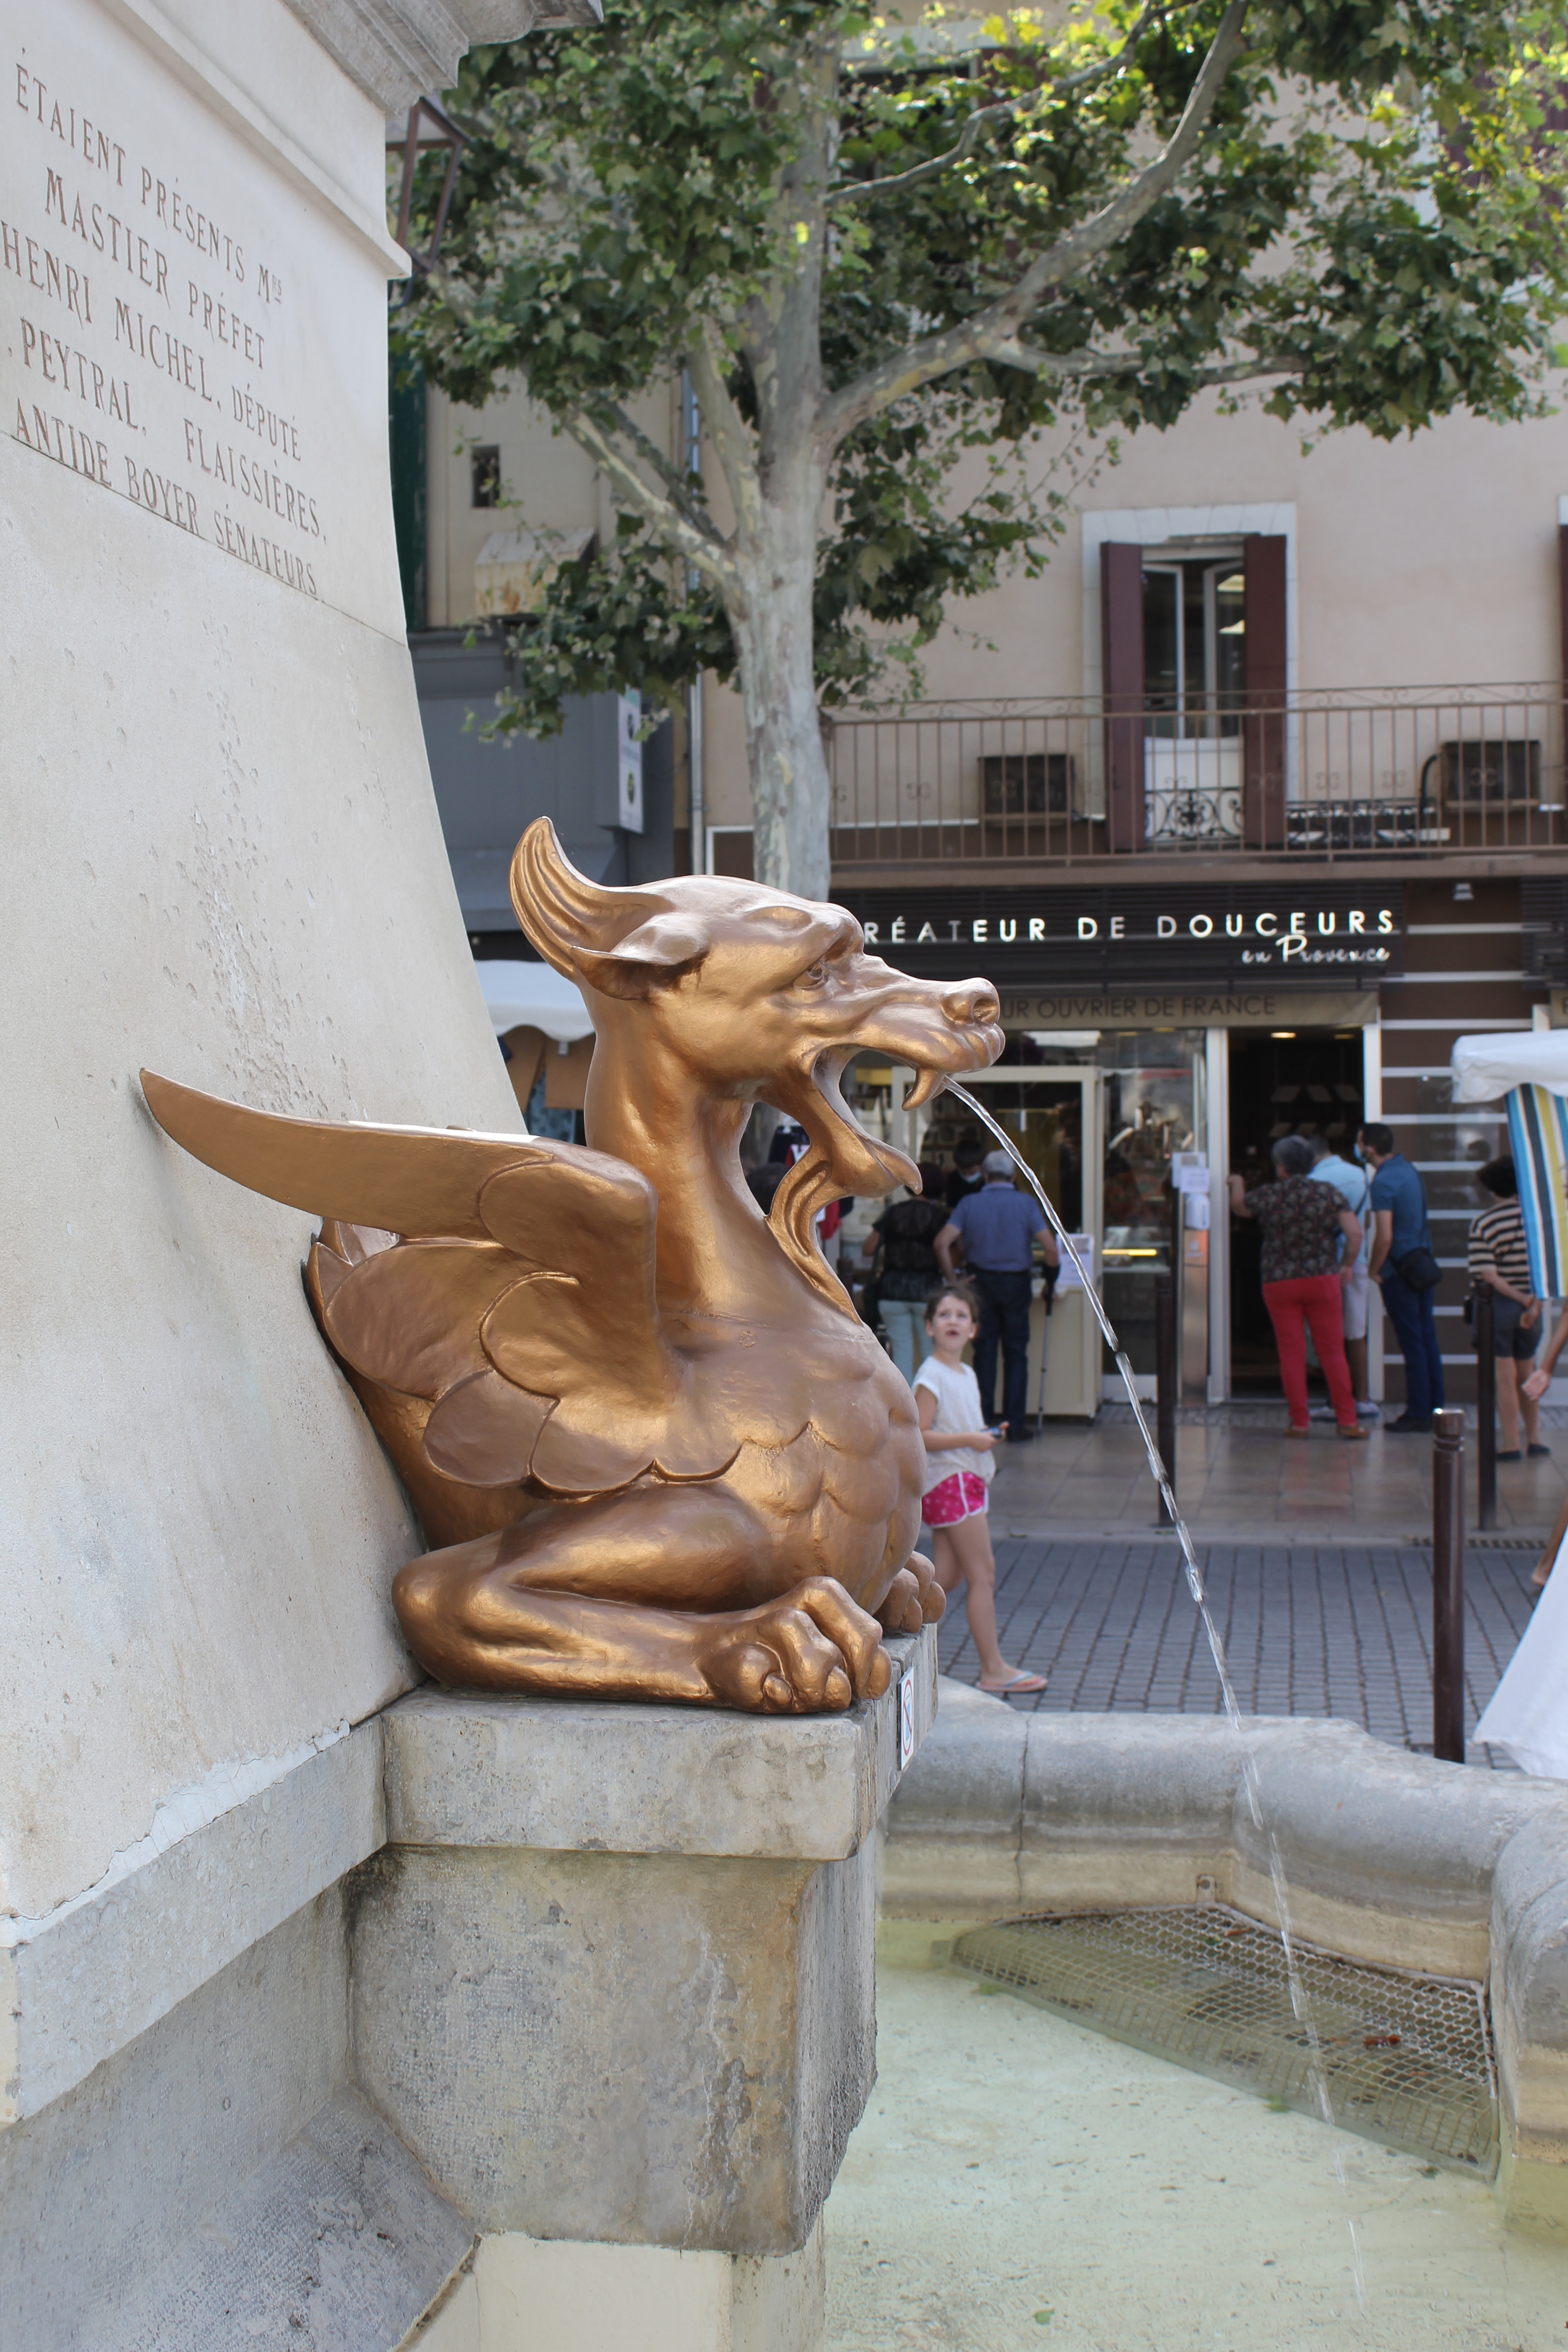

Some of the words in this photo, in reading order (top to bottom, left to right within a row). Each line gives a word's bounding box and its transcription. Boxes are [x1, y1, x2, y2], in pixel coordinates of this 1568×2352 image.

[16, 47, 126, 186] ÉTAIENT
[141, 166, 244, 282] PRÉSENTS
[1, 220, 92, 330] HENRI
[231, 382, 301, 462] DÉPUTÉ
[45, 167, 170, 310] MASTIER
[188, 280, 264, 369] PRÉFET
[16, 397, 112, 488] ANTIDE
[124, 455, 199, 536] BOYER
[214, 503, 316, 595] SÉNATEURS
[863, 916, 1045, 944] RÉATEUR
[1078, 916, 1125, 941] DE
[1157, 910, 1393, 938] DOUCEURS
[1001, 999, 1029, 1019] UR
[1037, 996, 1137, 1019] OUVRIER
[1144, 996, 1175, 1018] DE
[1182, 995, 1276, 1017] FRANCE
[1241, 950, 1271, 964] en
[1275, 934, 1390, 963] Provence
